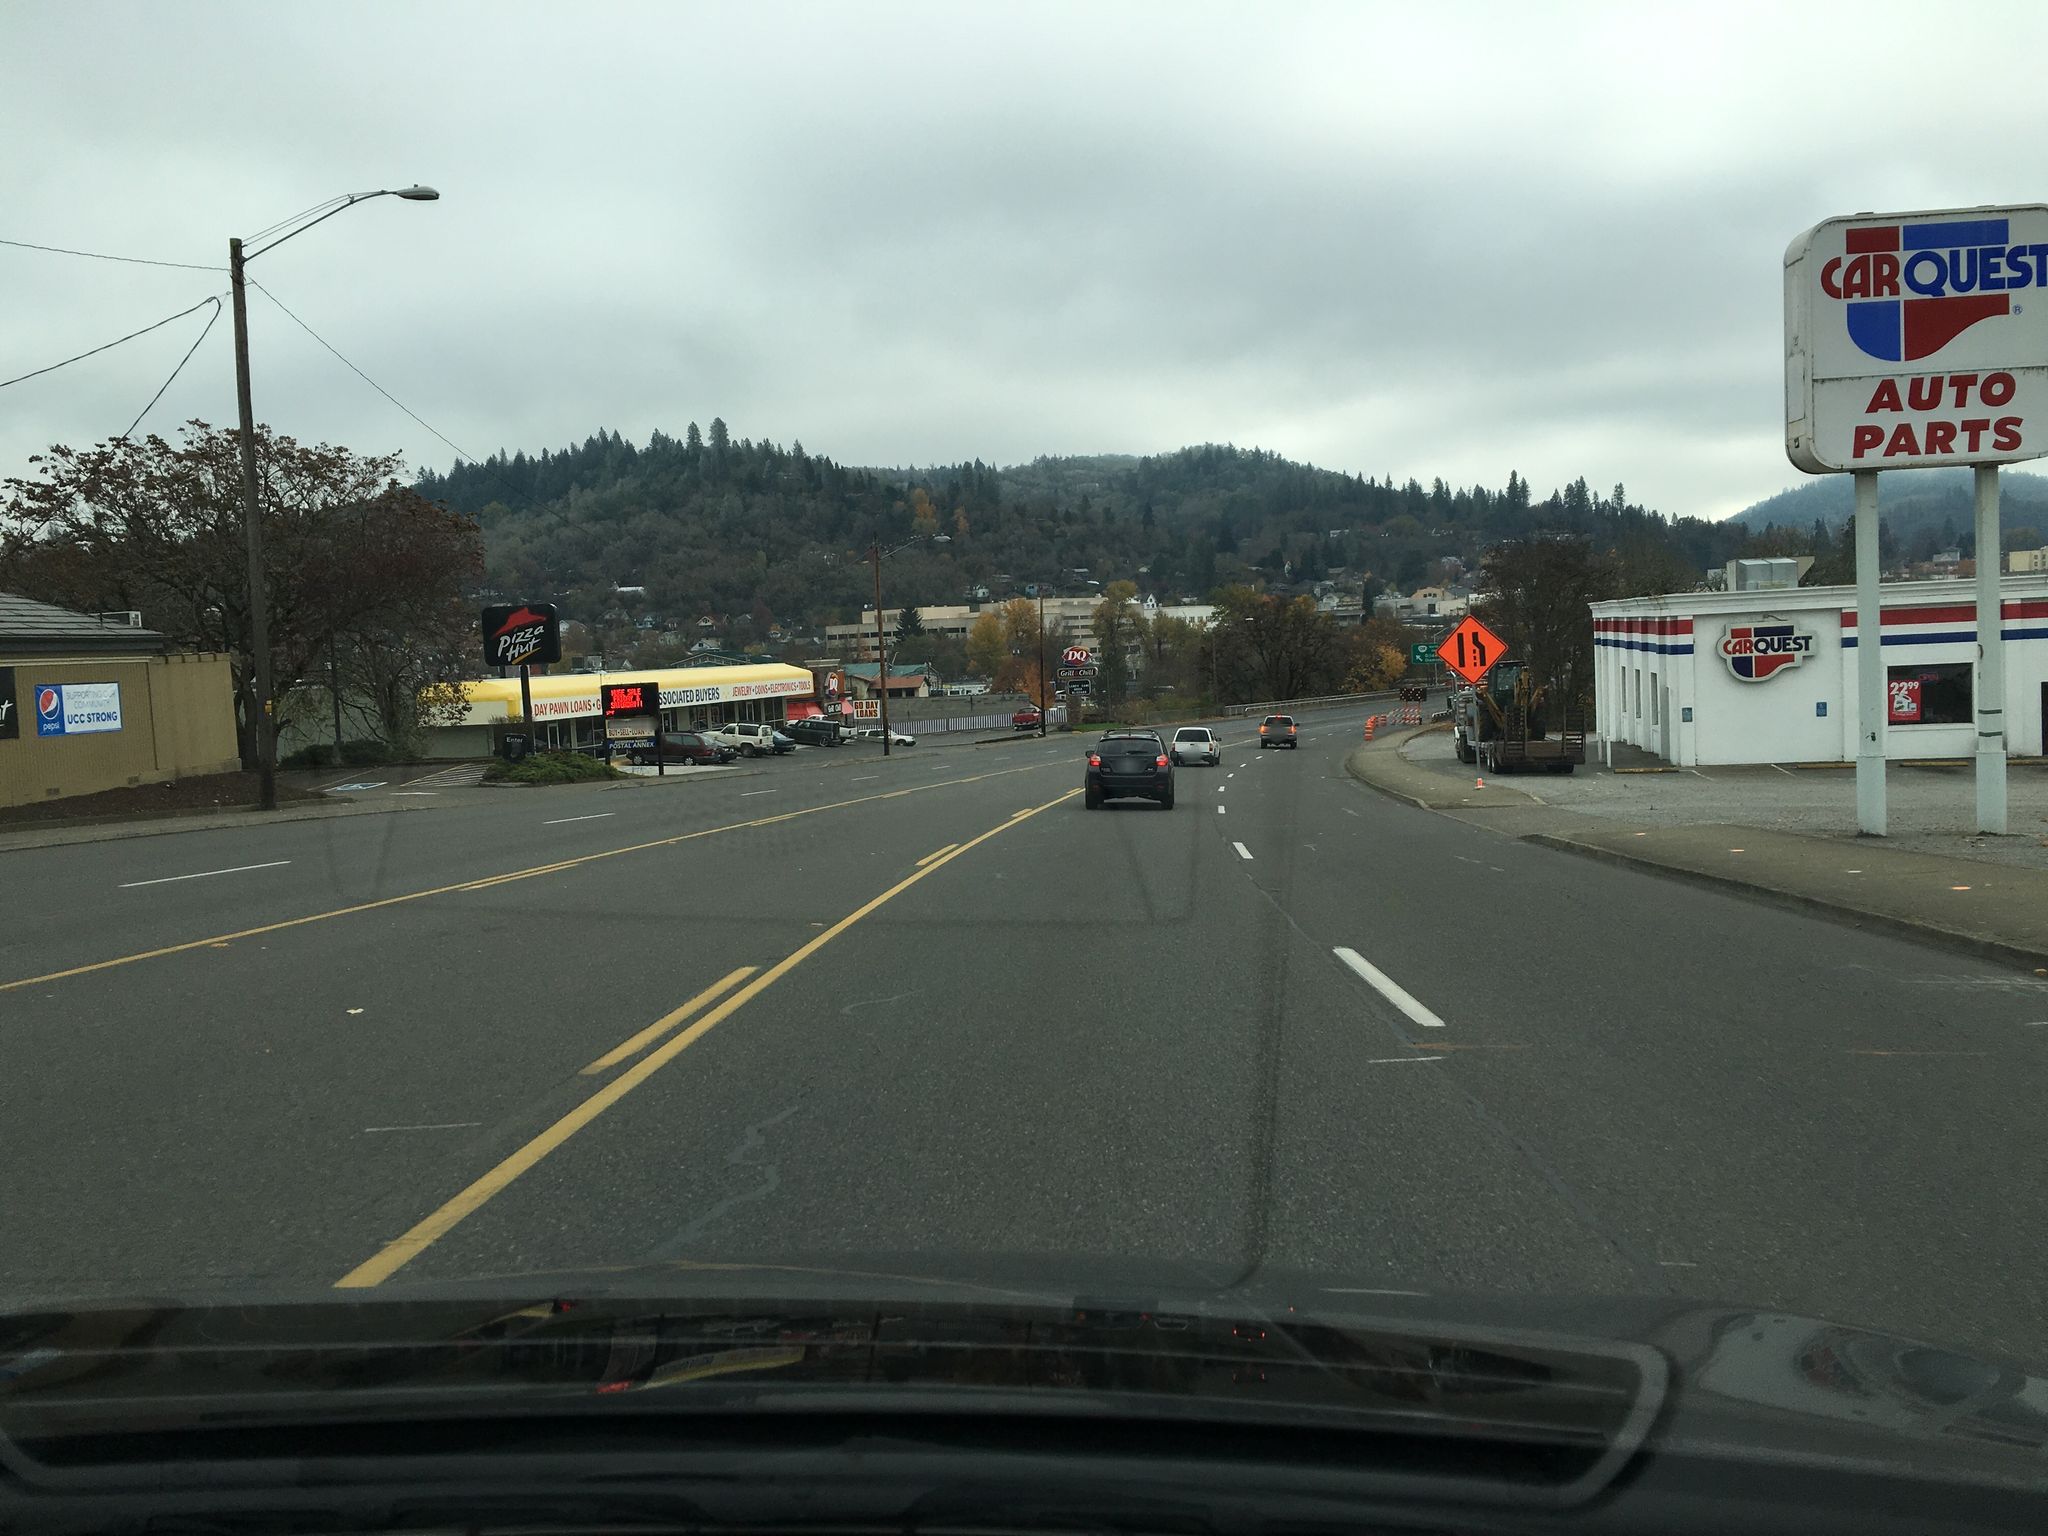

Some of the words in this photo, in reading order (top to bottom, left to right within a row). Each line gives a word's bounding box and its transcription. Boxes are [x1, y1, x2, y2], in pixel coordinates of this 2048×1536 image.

[1821, 243, 2048, 300] CARQUEST
[1865, 371, 2016, 414] AUTO
[1852, 416, 2024, 458] PARTS
[497, 625, 545, 657] Pizza
[506, 637, 541, 662] Hut
[1723, 635, 1812, 655] CARQUEST
[1068, 650, 1087, 661] DQ
[658, 690, 694, 706] SSOCIATED
[695, 687, 720, 701] BUYERS
[732, 686, 752, 697] JEWELRY
[534, 704, 547, 716] DAY
[549, 702, 570, 714] PAWN
[570, 700, 591, 712] LOANS
[856, 709, 878, 717] LOANS
[865, 701, 879, 709] DAY
[43, 721, 60, 731] pepsi
[67, 714, 85, 725] UCC
[87, 711, 118, 723] STRONG
